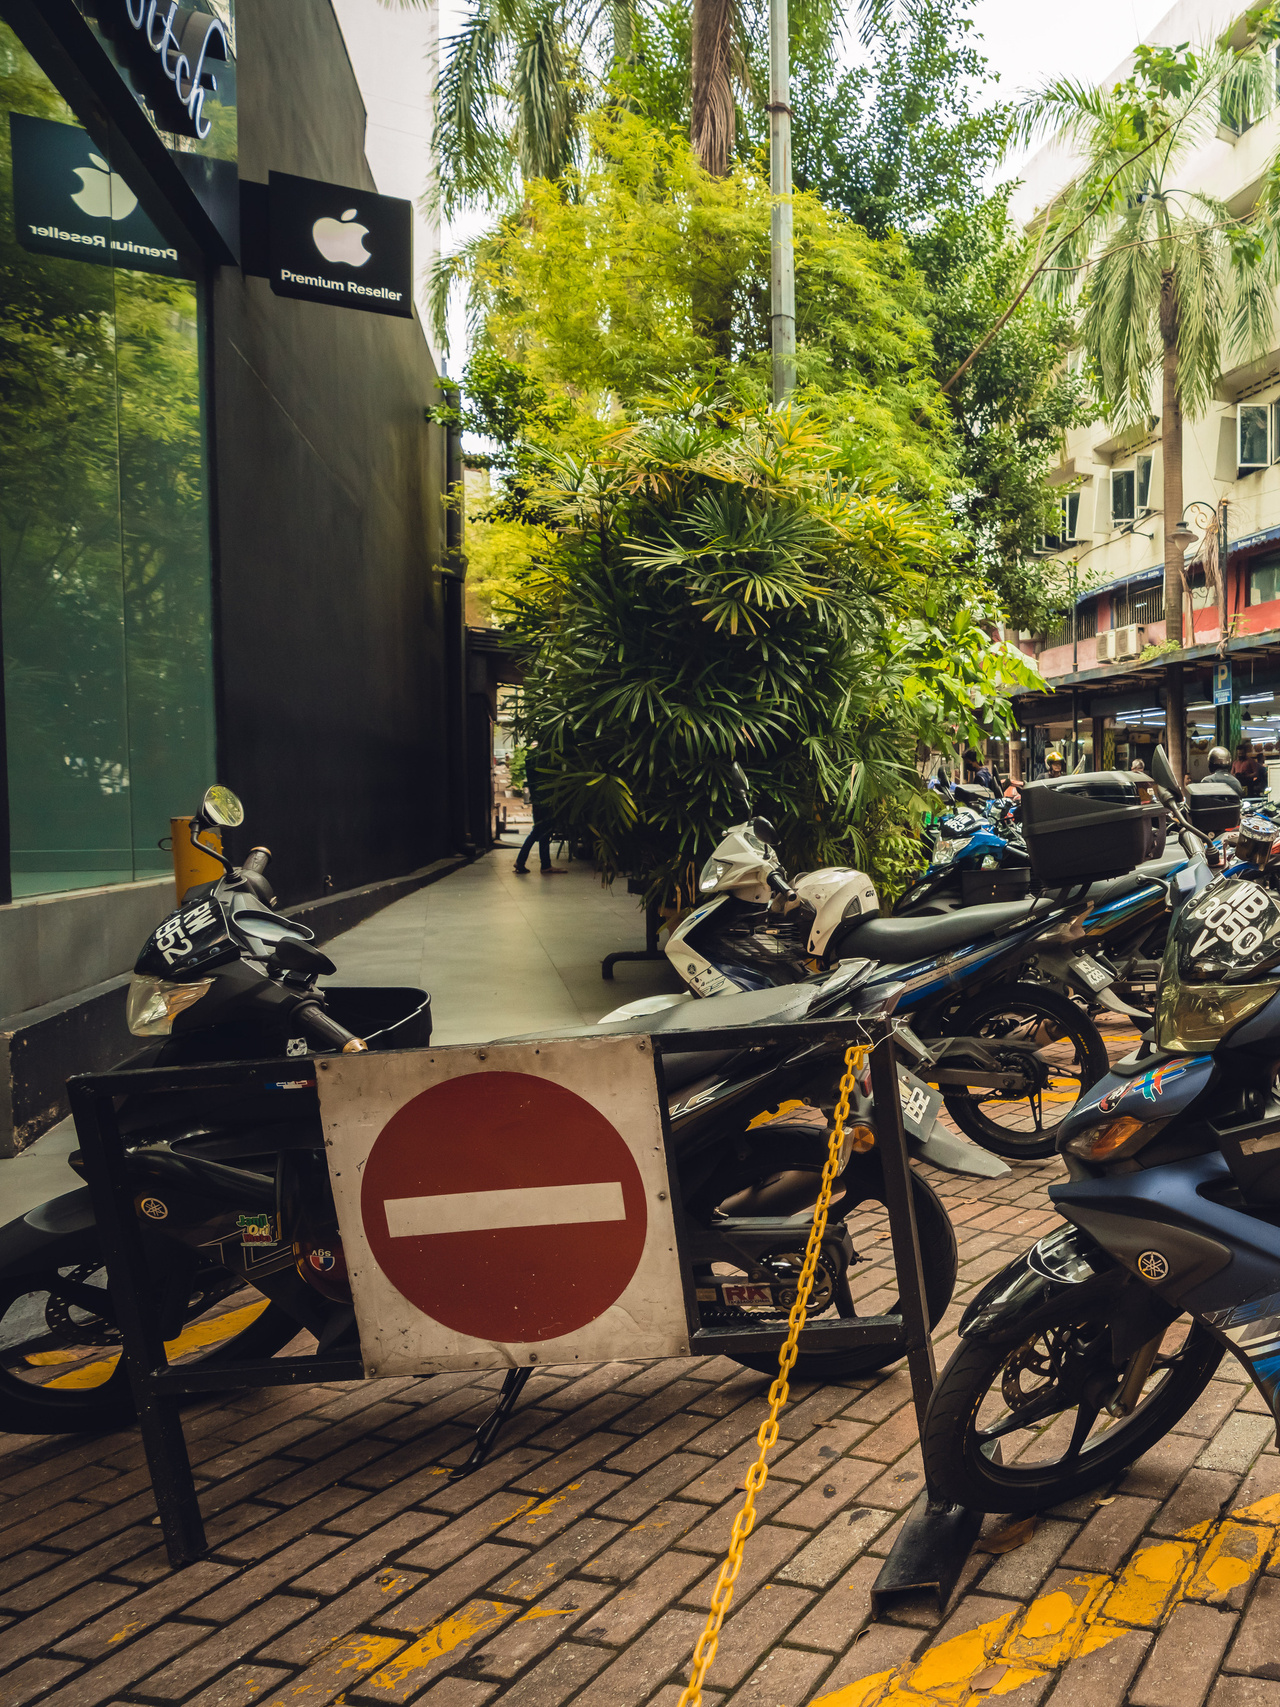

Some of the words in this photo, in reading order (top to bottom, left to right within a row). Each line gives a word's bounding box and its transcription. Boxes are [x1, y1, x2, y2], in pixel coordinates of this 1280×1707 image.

[281, 269, 344, 291] Premium
[347, 281, 402, 301] Reseller
[1217, 664, 1229, 689] P
[1226, 882, 1270, 919] WB
[183, 901, 217, 936] RW
[1195, 897, 1263, 955] 3050
[155, 914, 193, 965] 1952
[1190, 928, 1219, 957] V
[725, 1287, 769, 1301] RK
